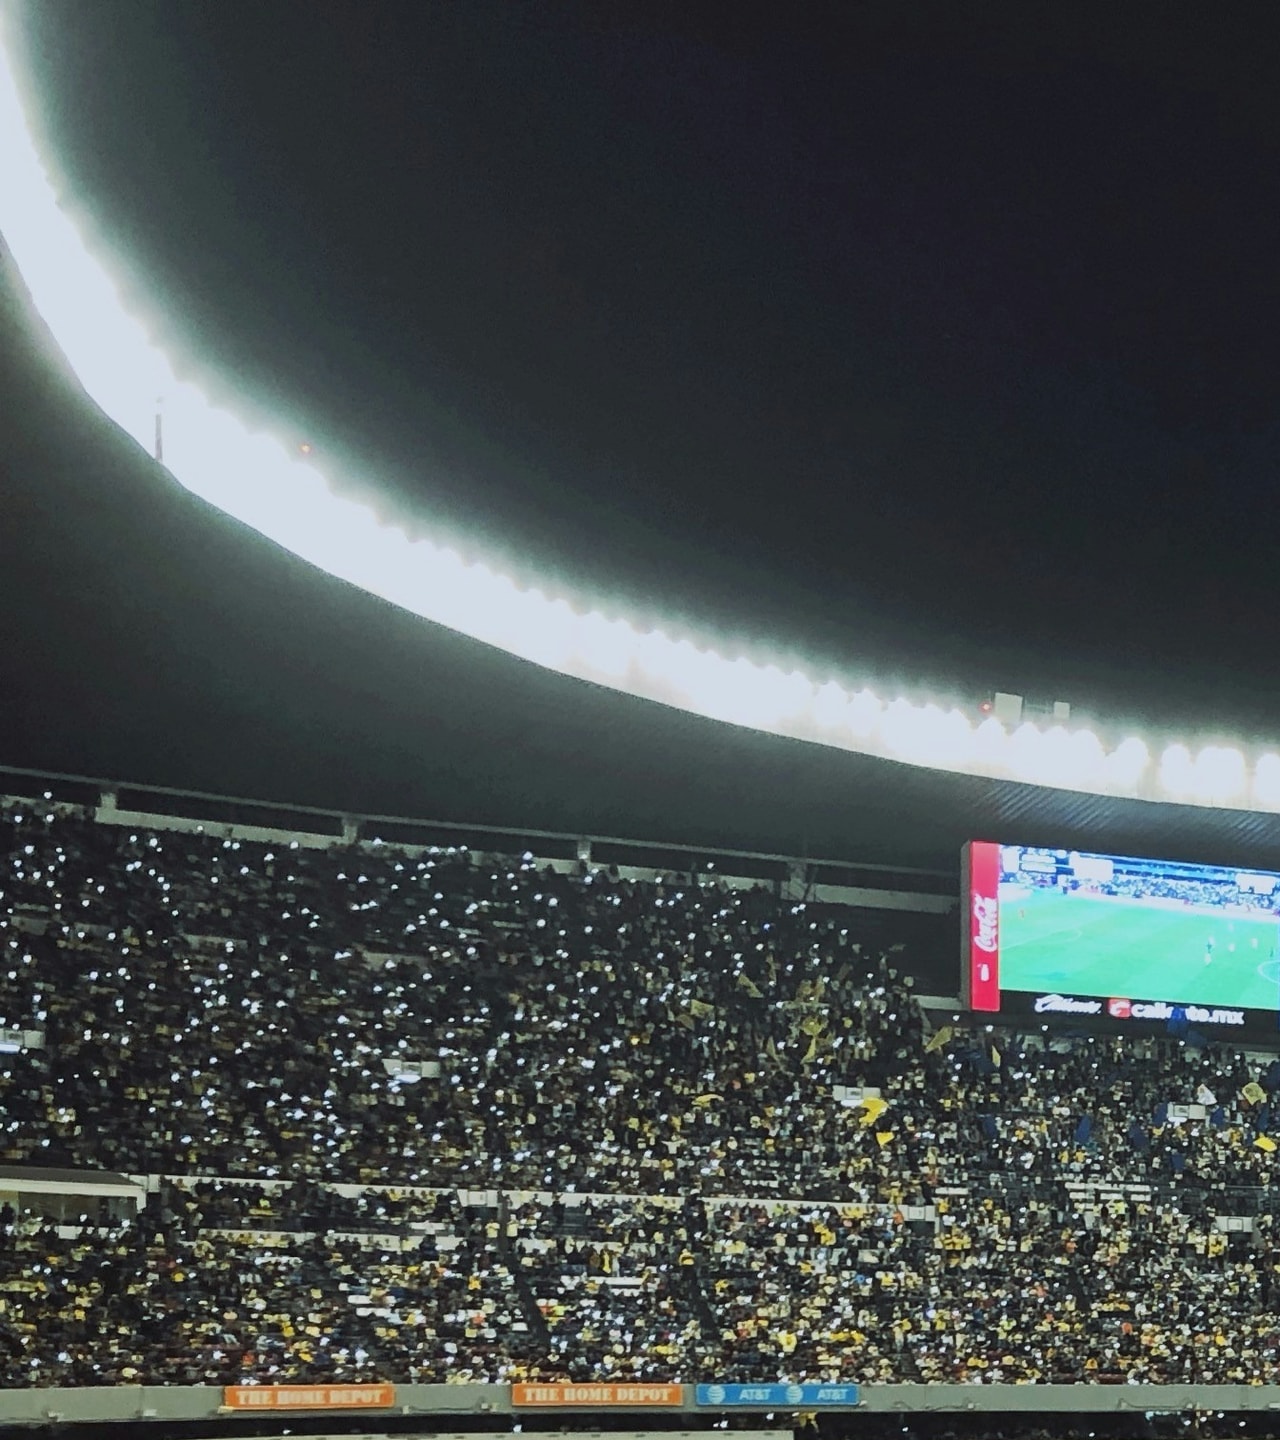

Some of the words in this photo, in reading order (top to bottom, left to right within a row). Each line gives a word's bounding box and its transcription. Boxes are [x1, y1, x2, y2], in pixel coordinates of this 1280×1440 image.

[236, 1390, 272, 1406] THE
[277, 1389, 325, 1406] HOME
[329, 1388, 385, 1405] DEPOT
[525, 1388, 560, 1403] THE
[563, 1387, 613, 1402] HOME
[616, 1386, 672, 1402] DEPOT
[739, 1388, 771, 1400] AT&T
[816, 1388, 849, 1400] AT&T
